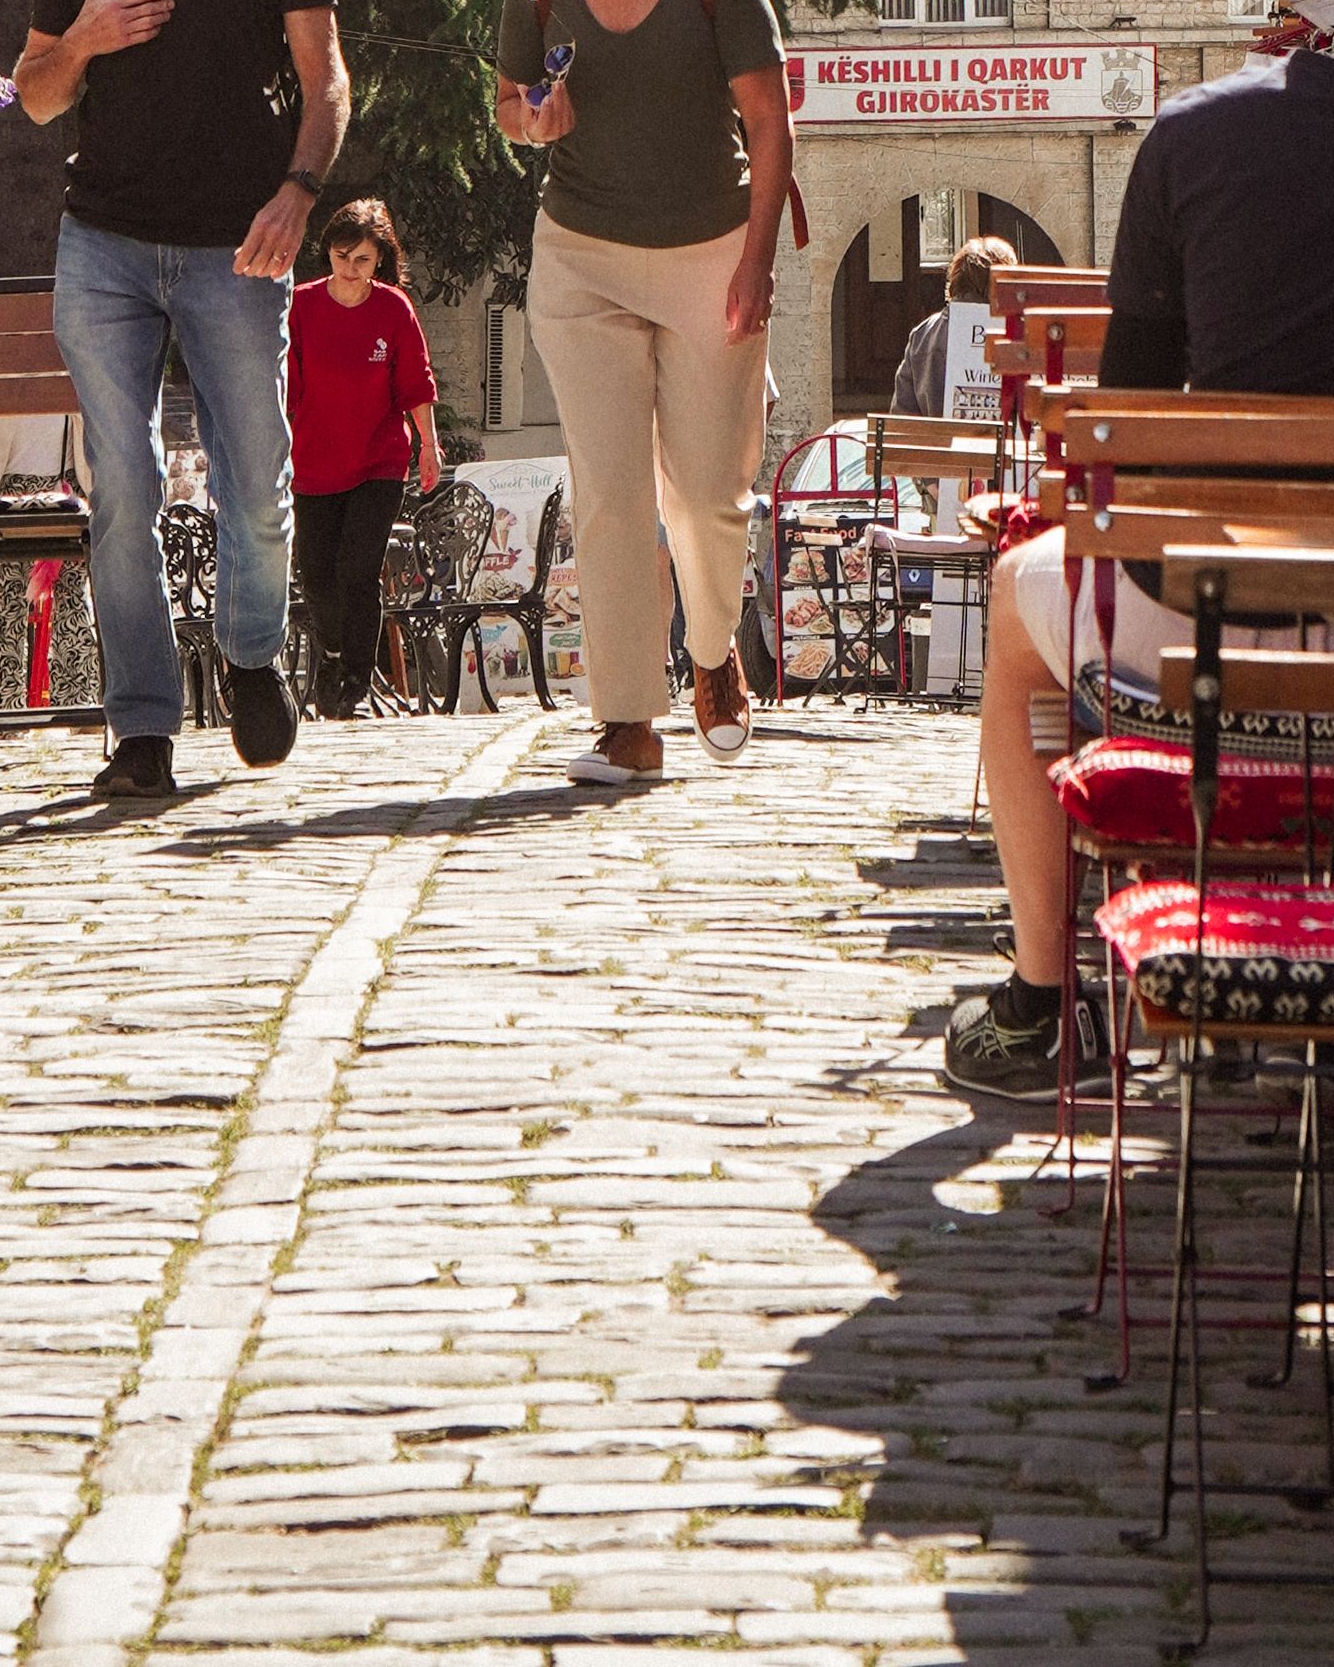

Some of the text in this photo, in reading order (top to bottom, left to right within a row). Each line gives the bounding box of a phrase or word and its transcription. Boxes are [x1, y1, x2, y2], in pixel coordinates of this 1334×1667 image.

[817, 55, 1087, 85] KËSHILLI I QARKUT
[856, 83, 1049, 113] GJIROKASTËR
